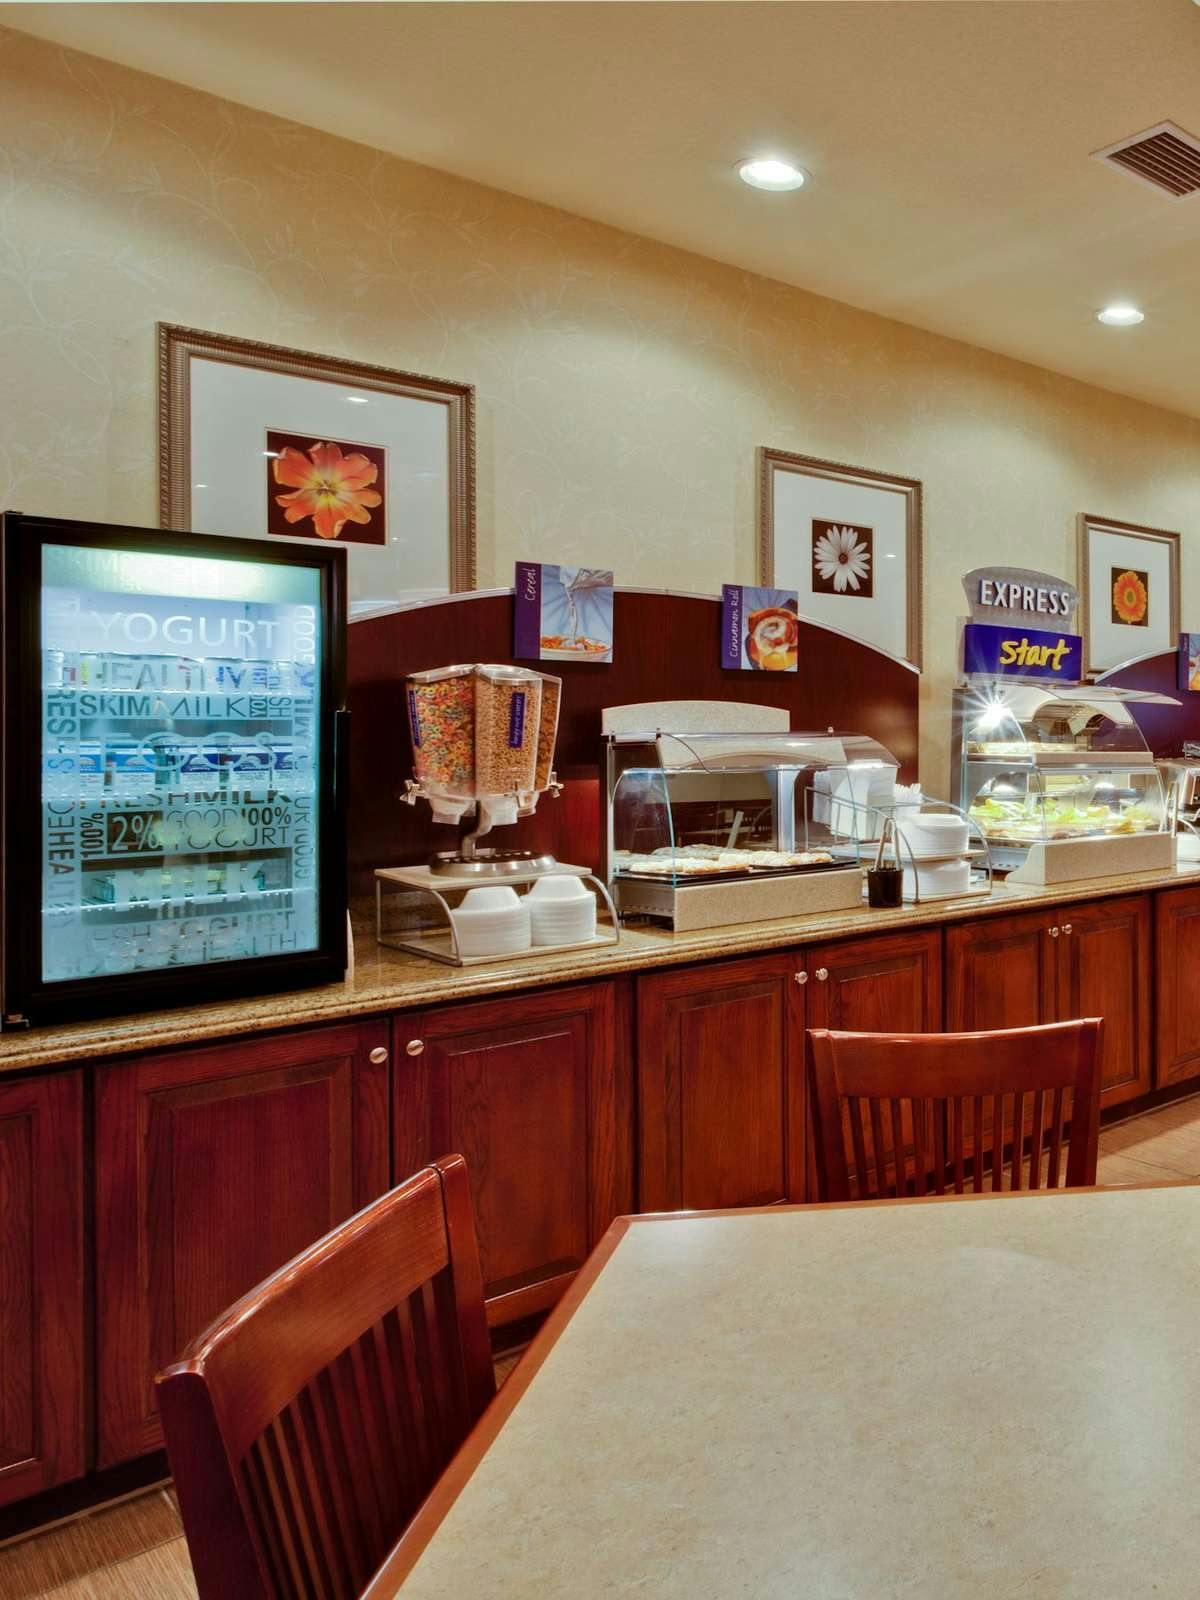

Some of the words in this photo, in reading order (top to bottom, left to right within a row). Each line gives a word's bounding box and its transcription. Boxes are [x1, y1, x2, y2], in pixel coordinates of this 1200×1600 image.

[523, 567, 537, 601] Cereal
[730, 588, 740, 607] Roll
[980, 579, 1070, 616] EXPRESS
[88, 610, 281, 649] YOGURT
[729, 608, 739, 658] Cinnamon
[1000, 637, 1071, 671] Start
[80, 812, 104, 858] 100%
[111, 814, 158, 851] 2%
[166, 808, 238, 829] GOOD
